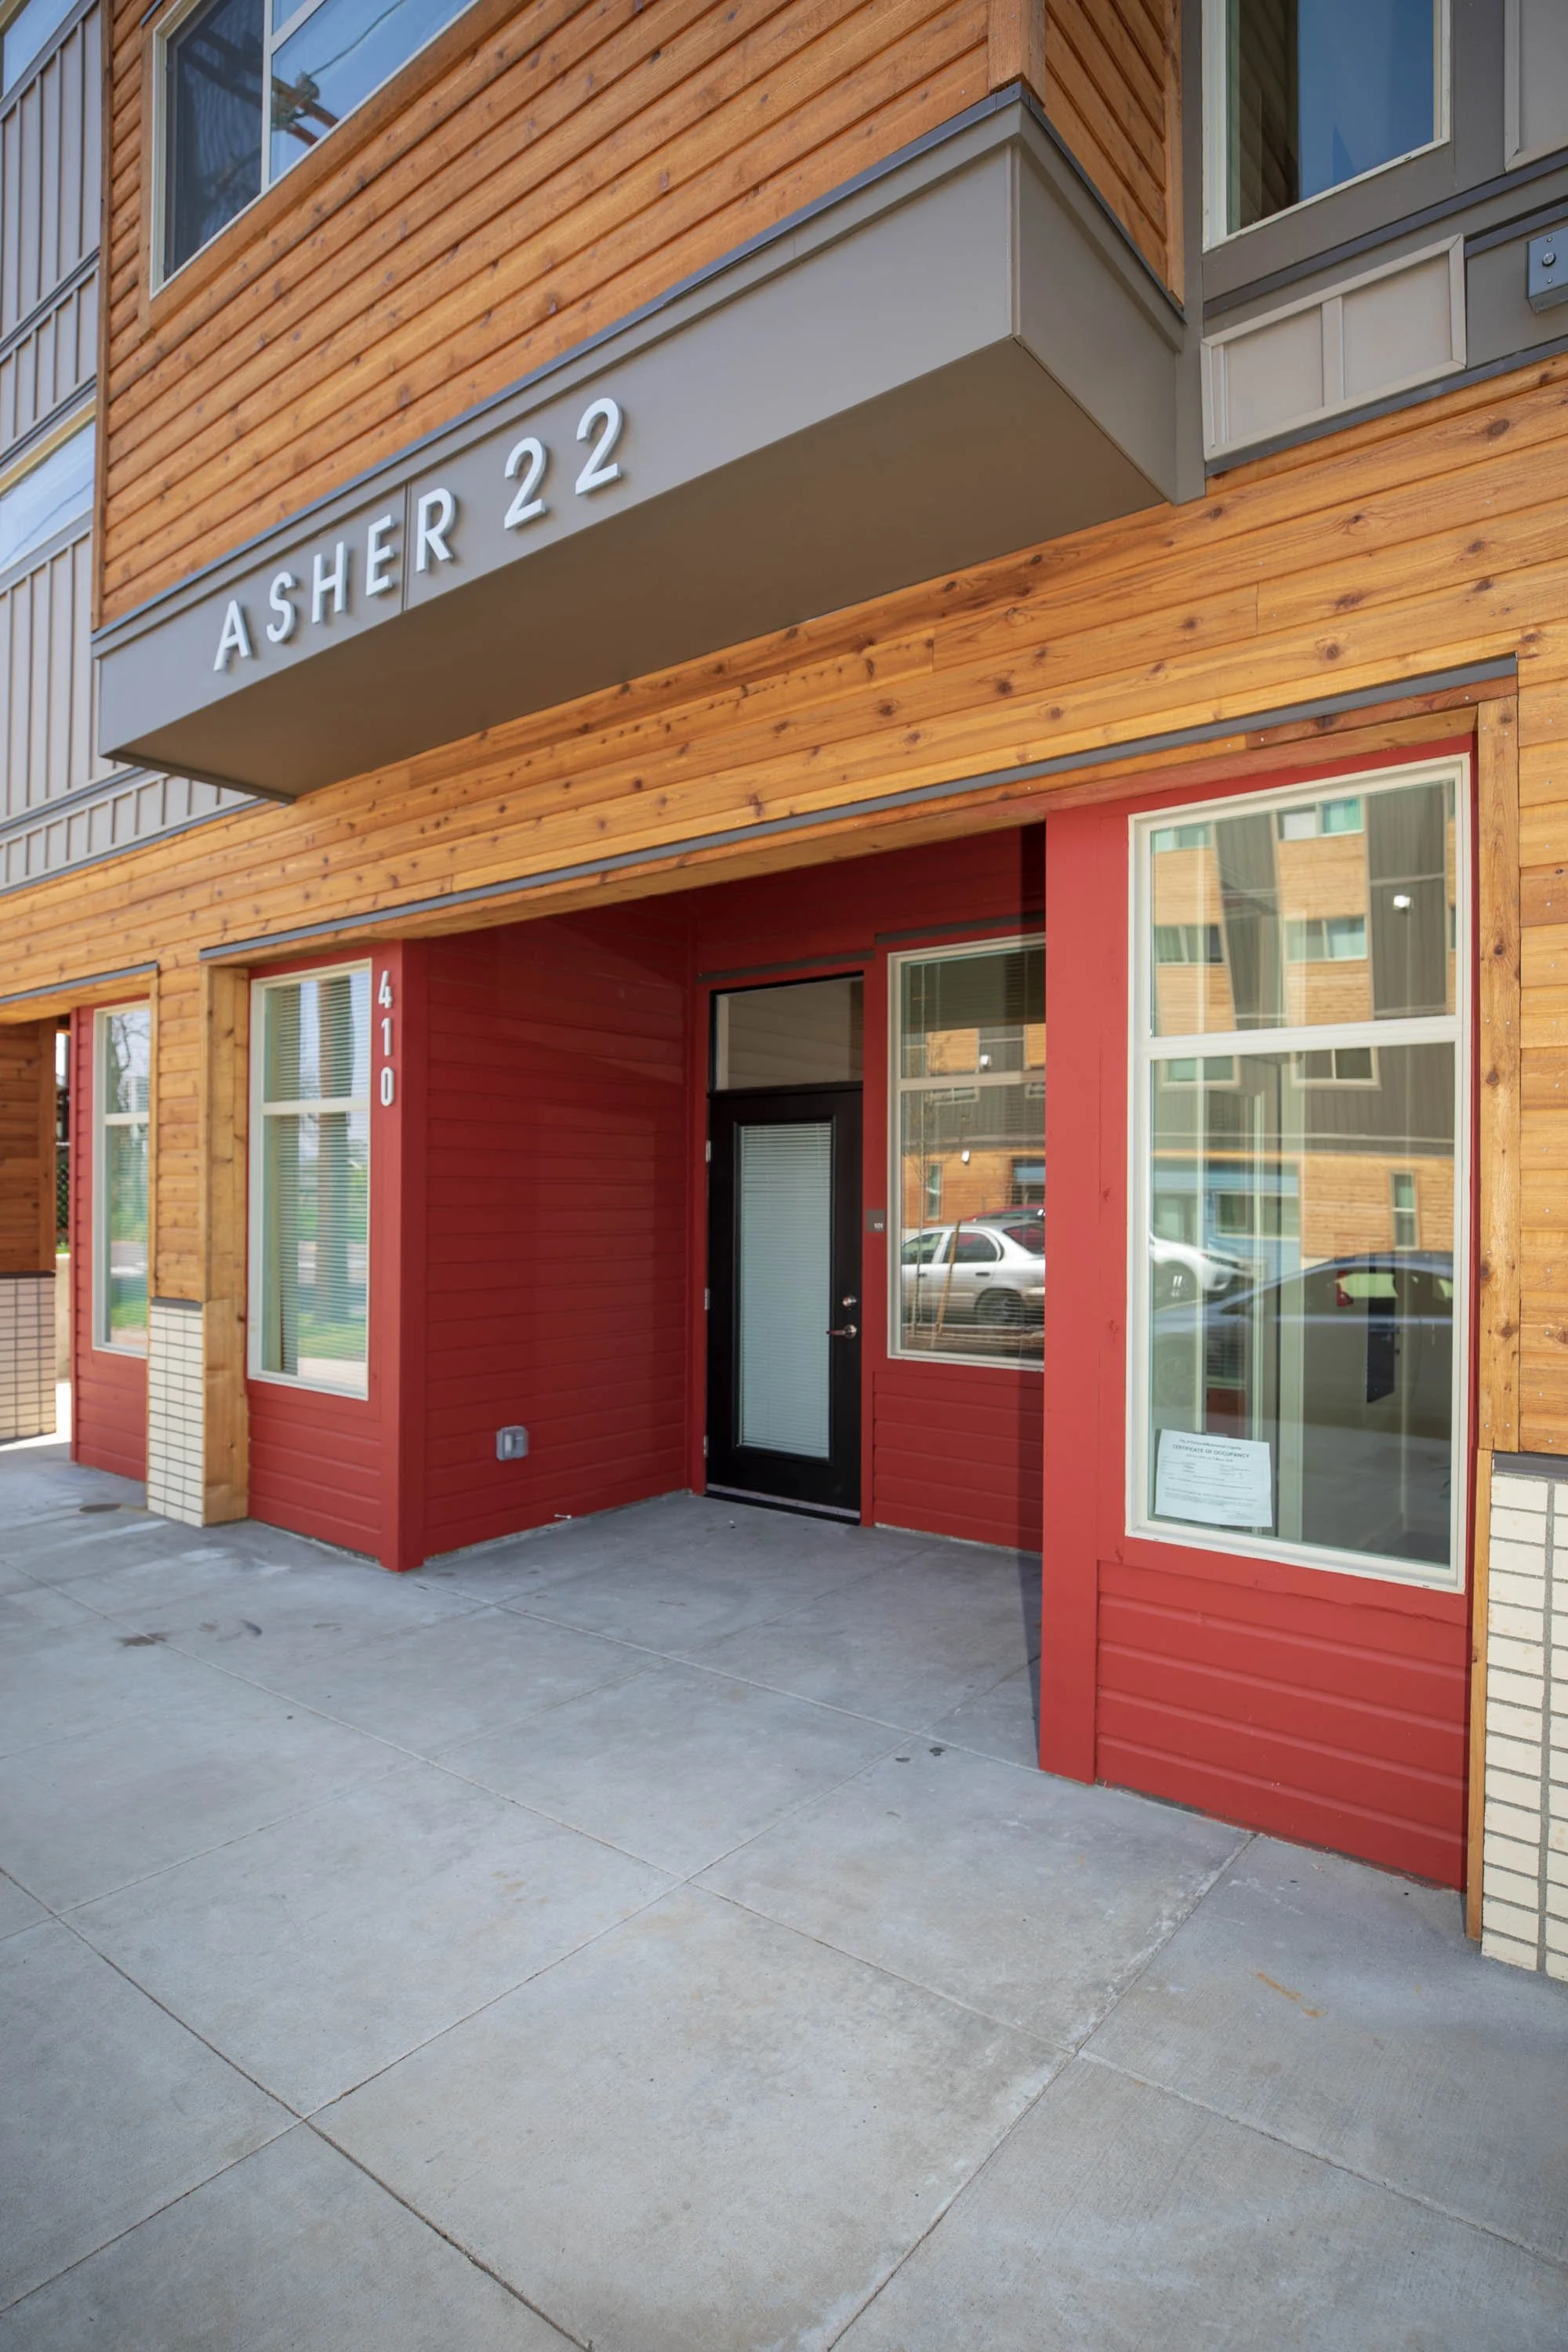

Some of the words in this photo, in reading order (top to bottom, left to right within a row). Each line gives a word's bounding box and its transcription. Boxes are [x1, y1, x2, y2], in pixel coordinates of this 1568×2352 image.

[212, 487, 456, 672] ASHER
[503, 397, 624, 531] 22
[378, 970, 394, 1107] 410
